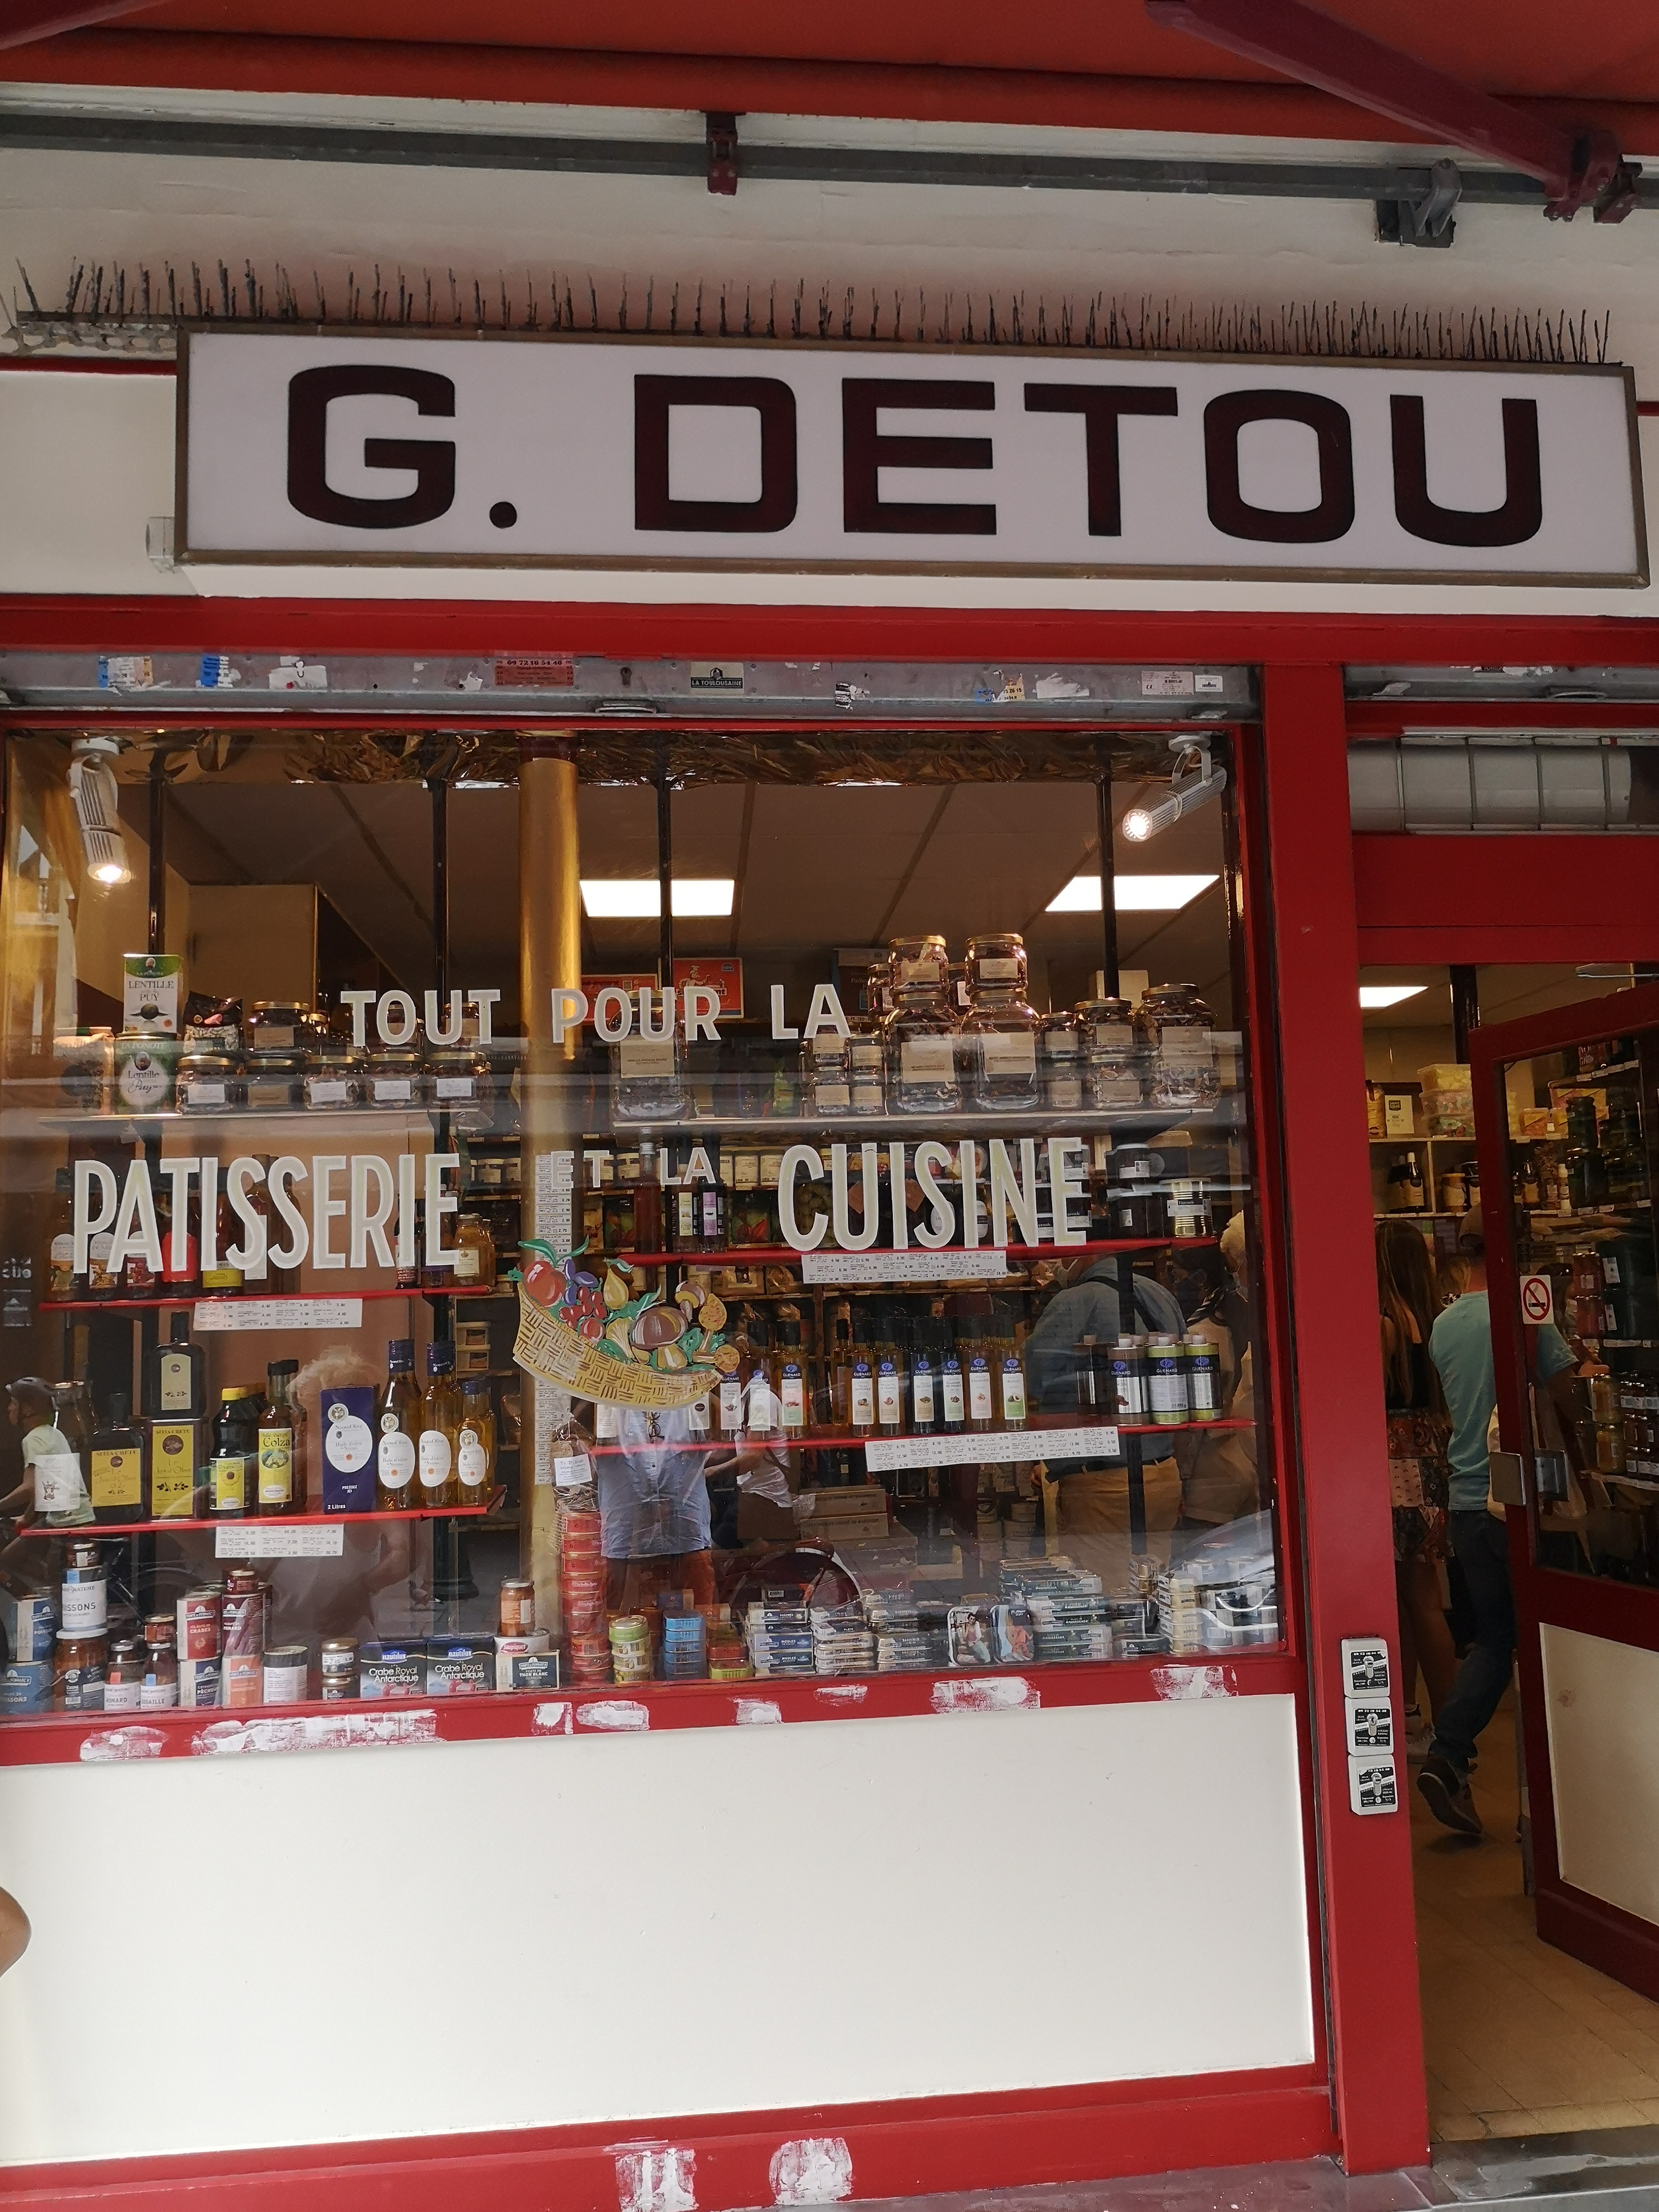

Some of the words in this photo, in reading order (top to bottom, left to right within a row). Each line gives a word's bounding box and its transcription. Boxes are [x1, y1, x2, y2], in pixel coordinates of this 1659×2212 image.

[288, 365, 518, 528] G.
[634, 373, 1542, 547] DETOU
[129, 981, 174, 989] LENTILLE
[140, 993, 159, 1002] PUY
[340, 989, 501, 1047] TOUT
[551, 986, 722, 1042] POUR
[770, 984, 852, 1040] LA
[73, 1153, 460, 1274] PATISSERIE
[551, 1149, 610, 1189] ET
[660, 1146, 717, 1185] LA
[778, 1137, 1086, 1251] CUISINE
[263, 1438, 290, 1447] Colza
[382, 1651, 406, 1660] nautilus
[448, 1649, 472, 1657] nautilus
[368, 1667, 394, 1676] Crabe
[395, 1666, 418, 1675] Royal
[435, 1665, 460, 1673] Crabe
[462, 1663, 483, 1672] Royal
[374, 1674, 419, 1684] Antarctique
[440, 1671, 485, 1680] Antarctique
